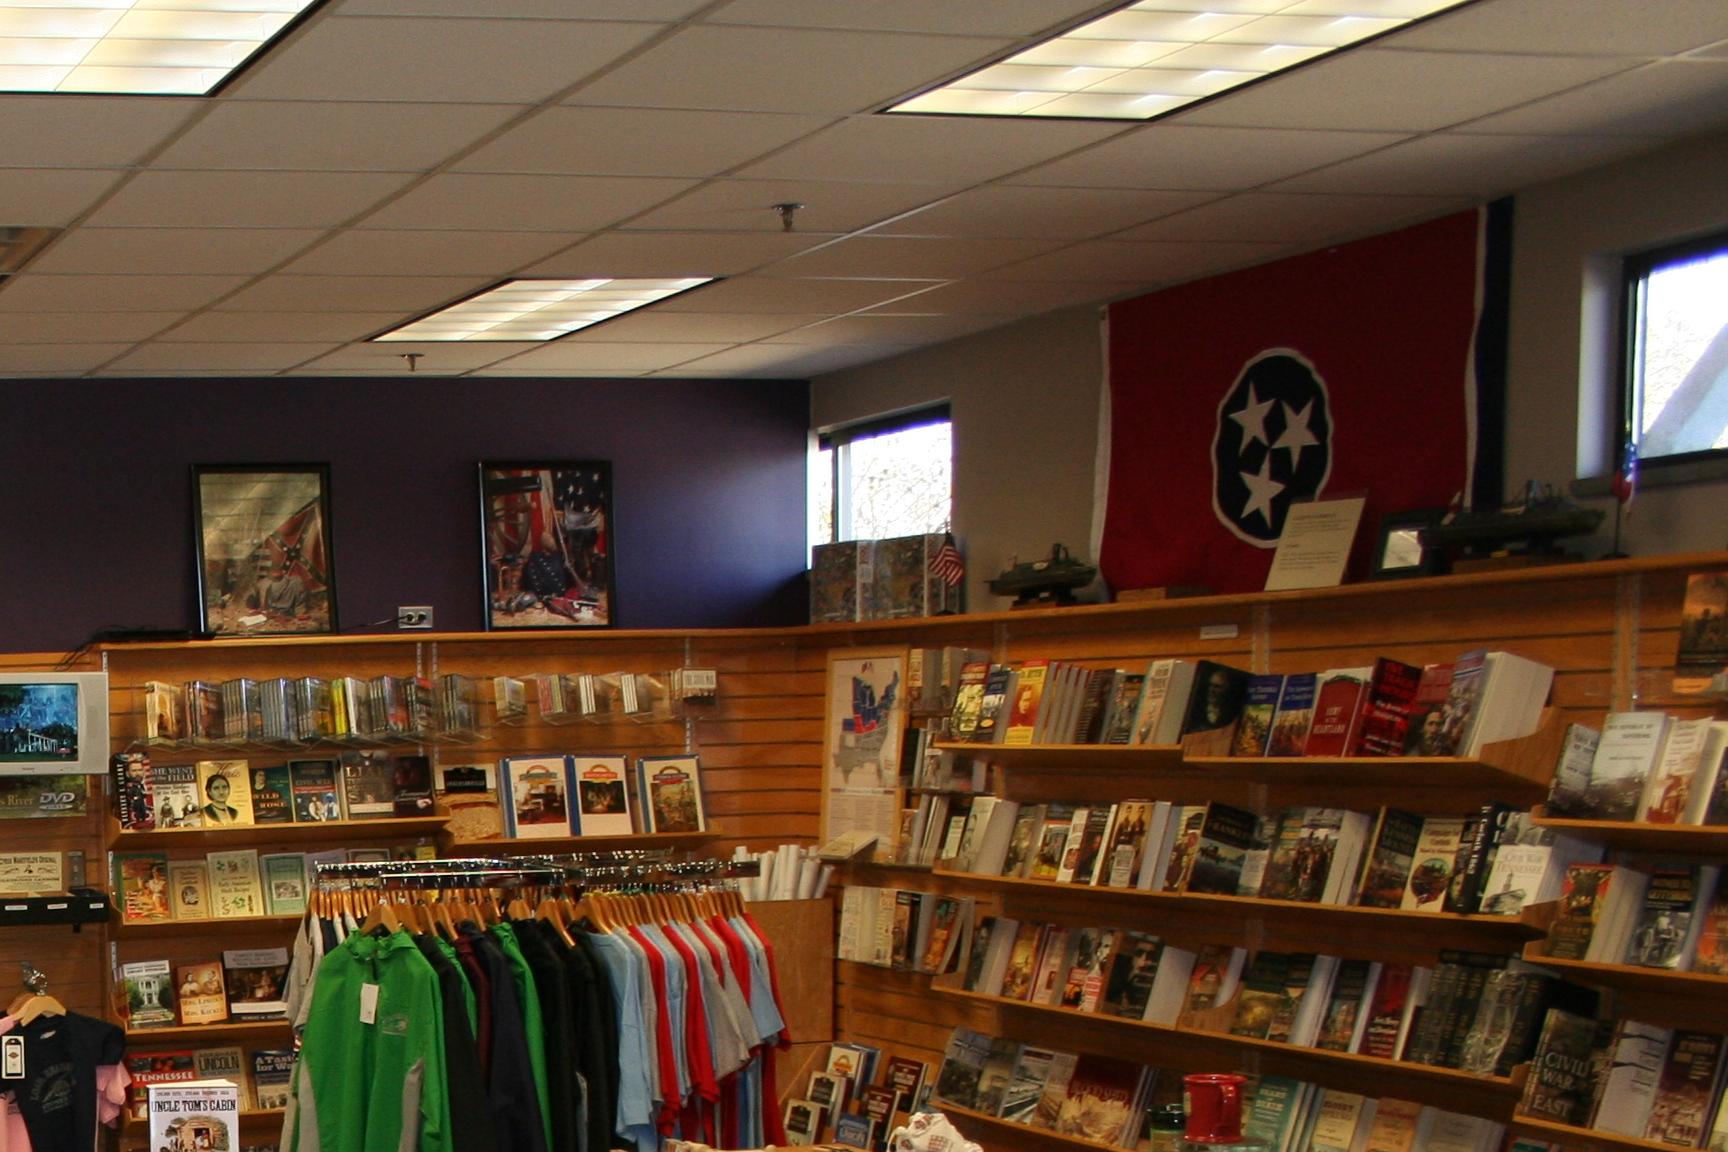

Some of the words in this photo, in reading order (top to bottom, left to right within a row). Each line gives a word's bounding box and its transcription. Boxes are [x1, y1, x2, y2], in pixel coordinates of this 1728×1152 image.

[8, 795, 33, 806] River
[40, 792, 75, 803] DVD
[134, 1072, 193, 1082] TENNESSEE
[152, 1101, 180, 1112] UNCLE
[182, 1100, 208, 1111] TOM'S
[210, 1100, 235, 1111] CABIN
